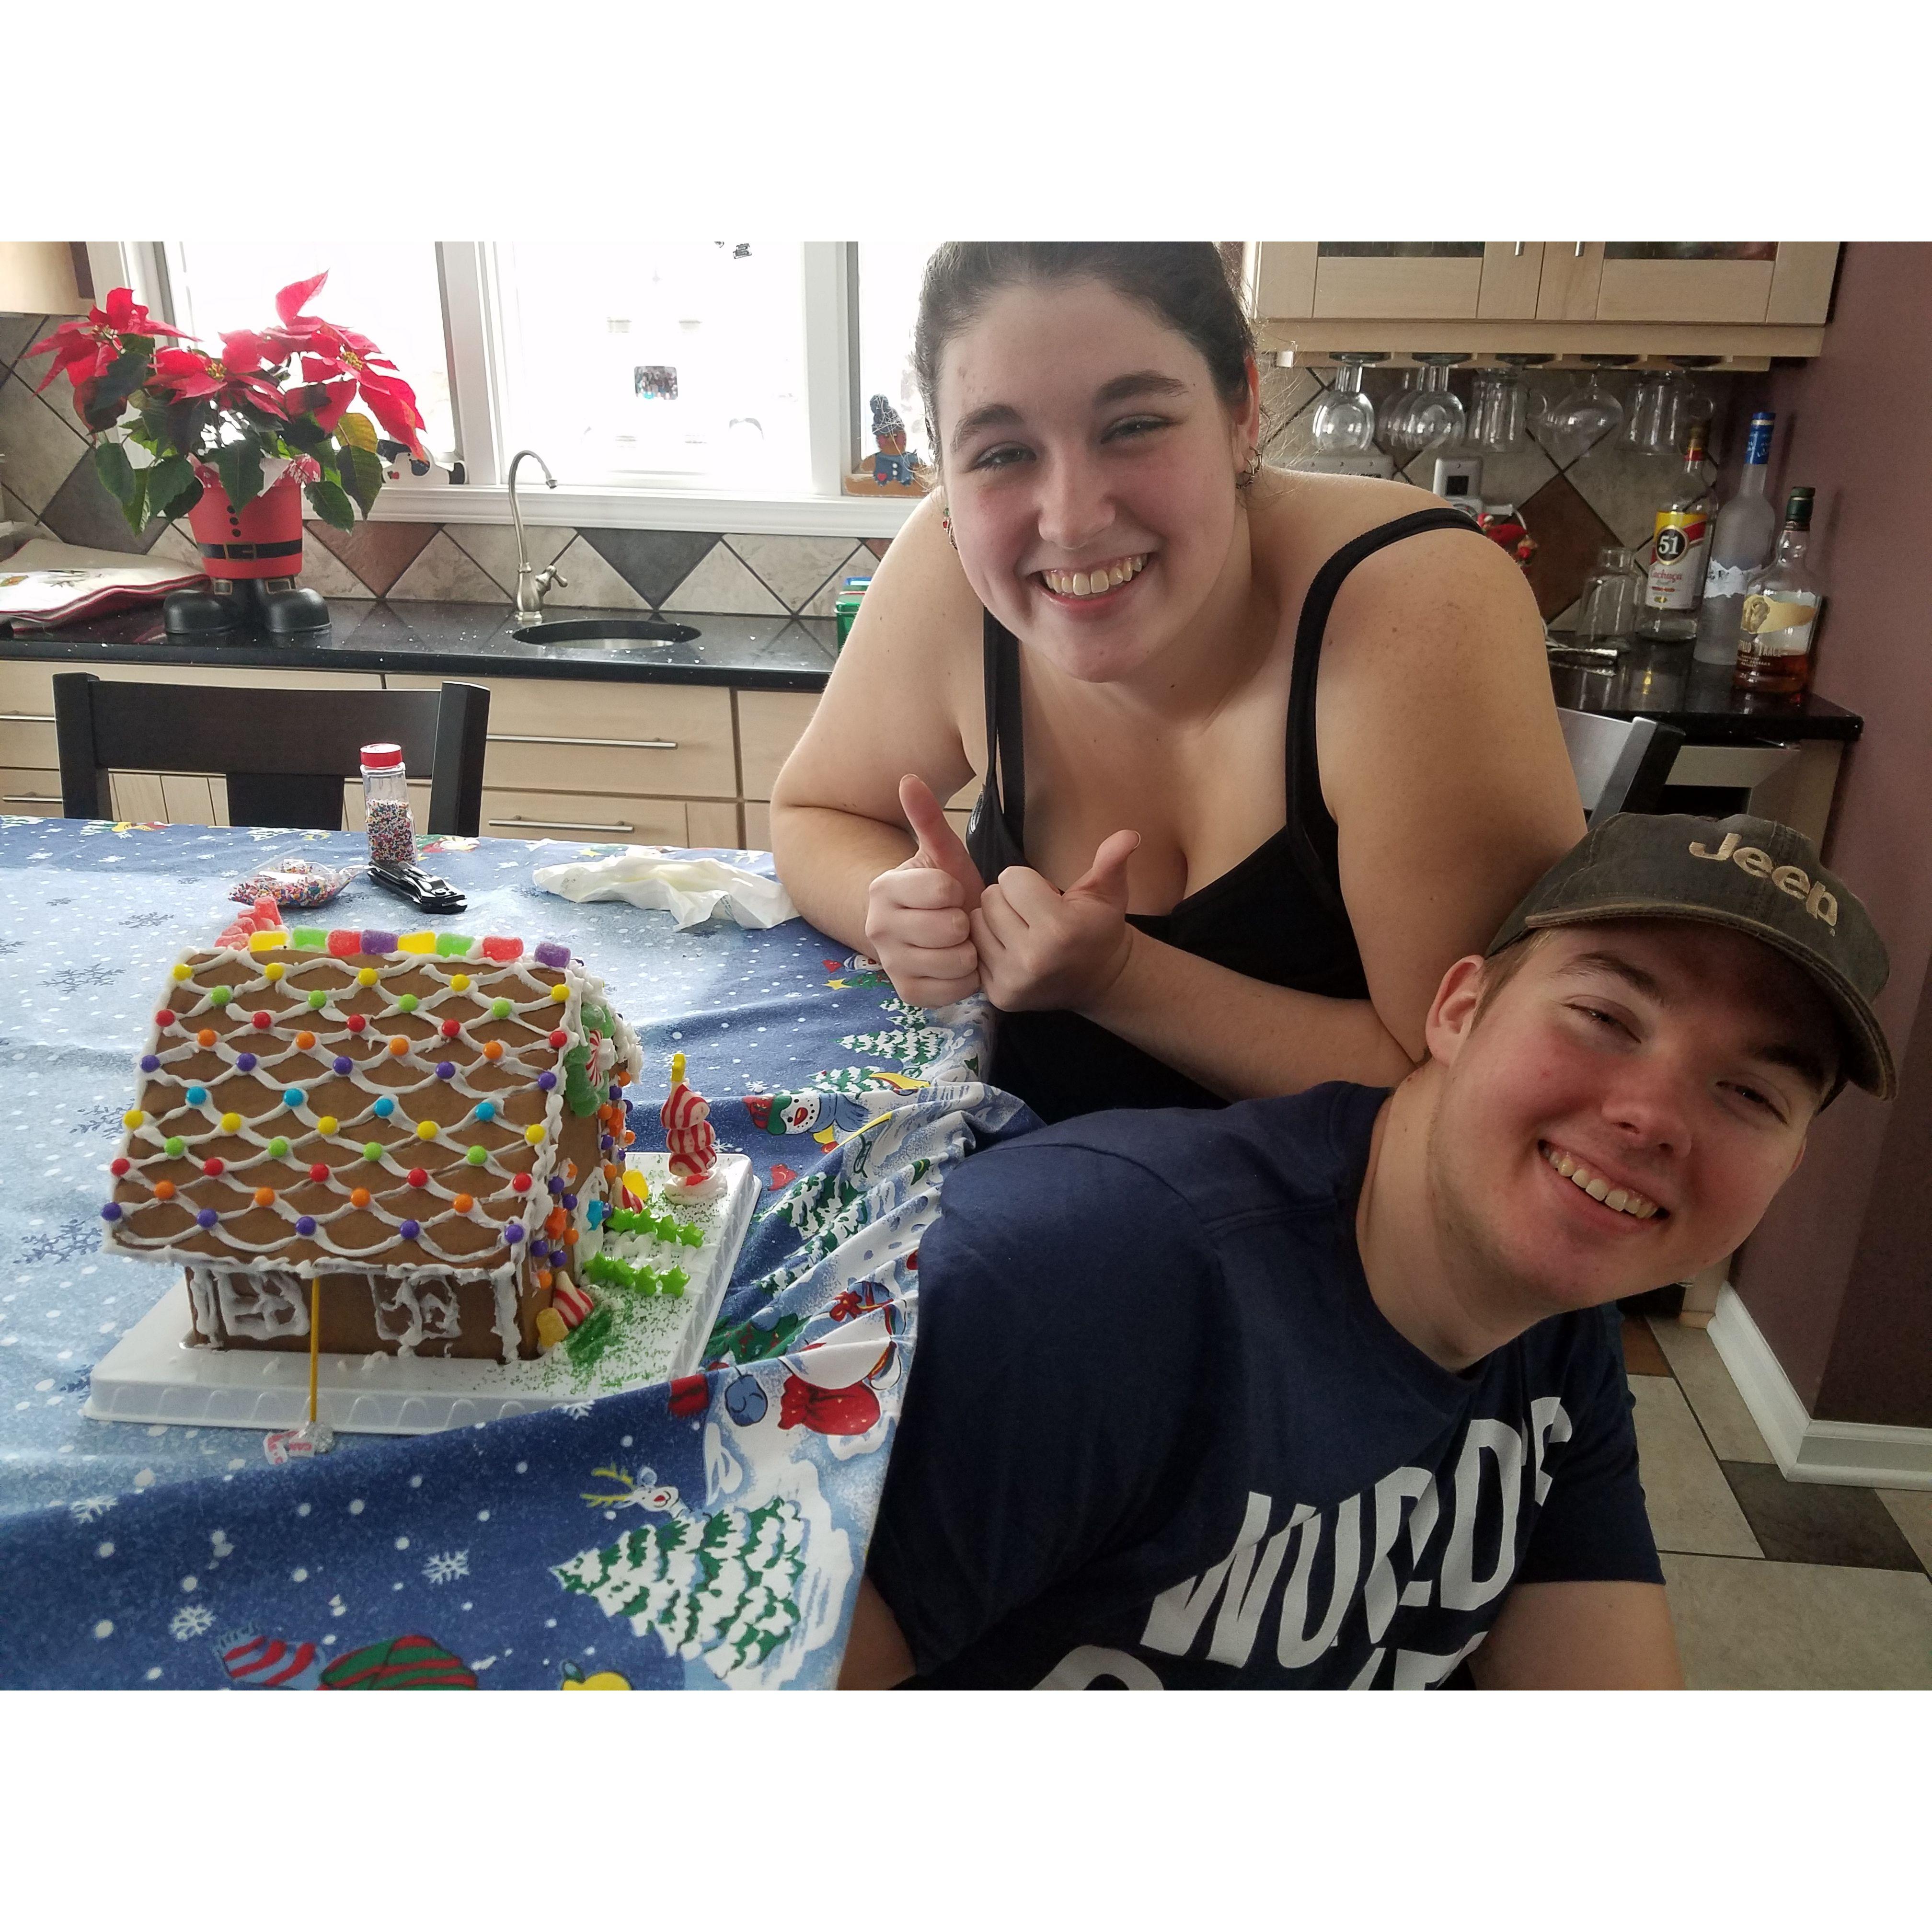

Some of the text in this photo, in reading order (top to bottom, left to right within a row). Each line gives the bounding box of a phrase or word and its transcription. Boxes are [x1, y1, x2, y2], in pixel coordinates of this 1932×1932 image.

[1658, 535, 1679, 555] 51
[1688, 832, 1839, 927] Jeep
[1139, 1396, 1573, 1668] WORD'S
